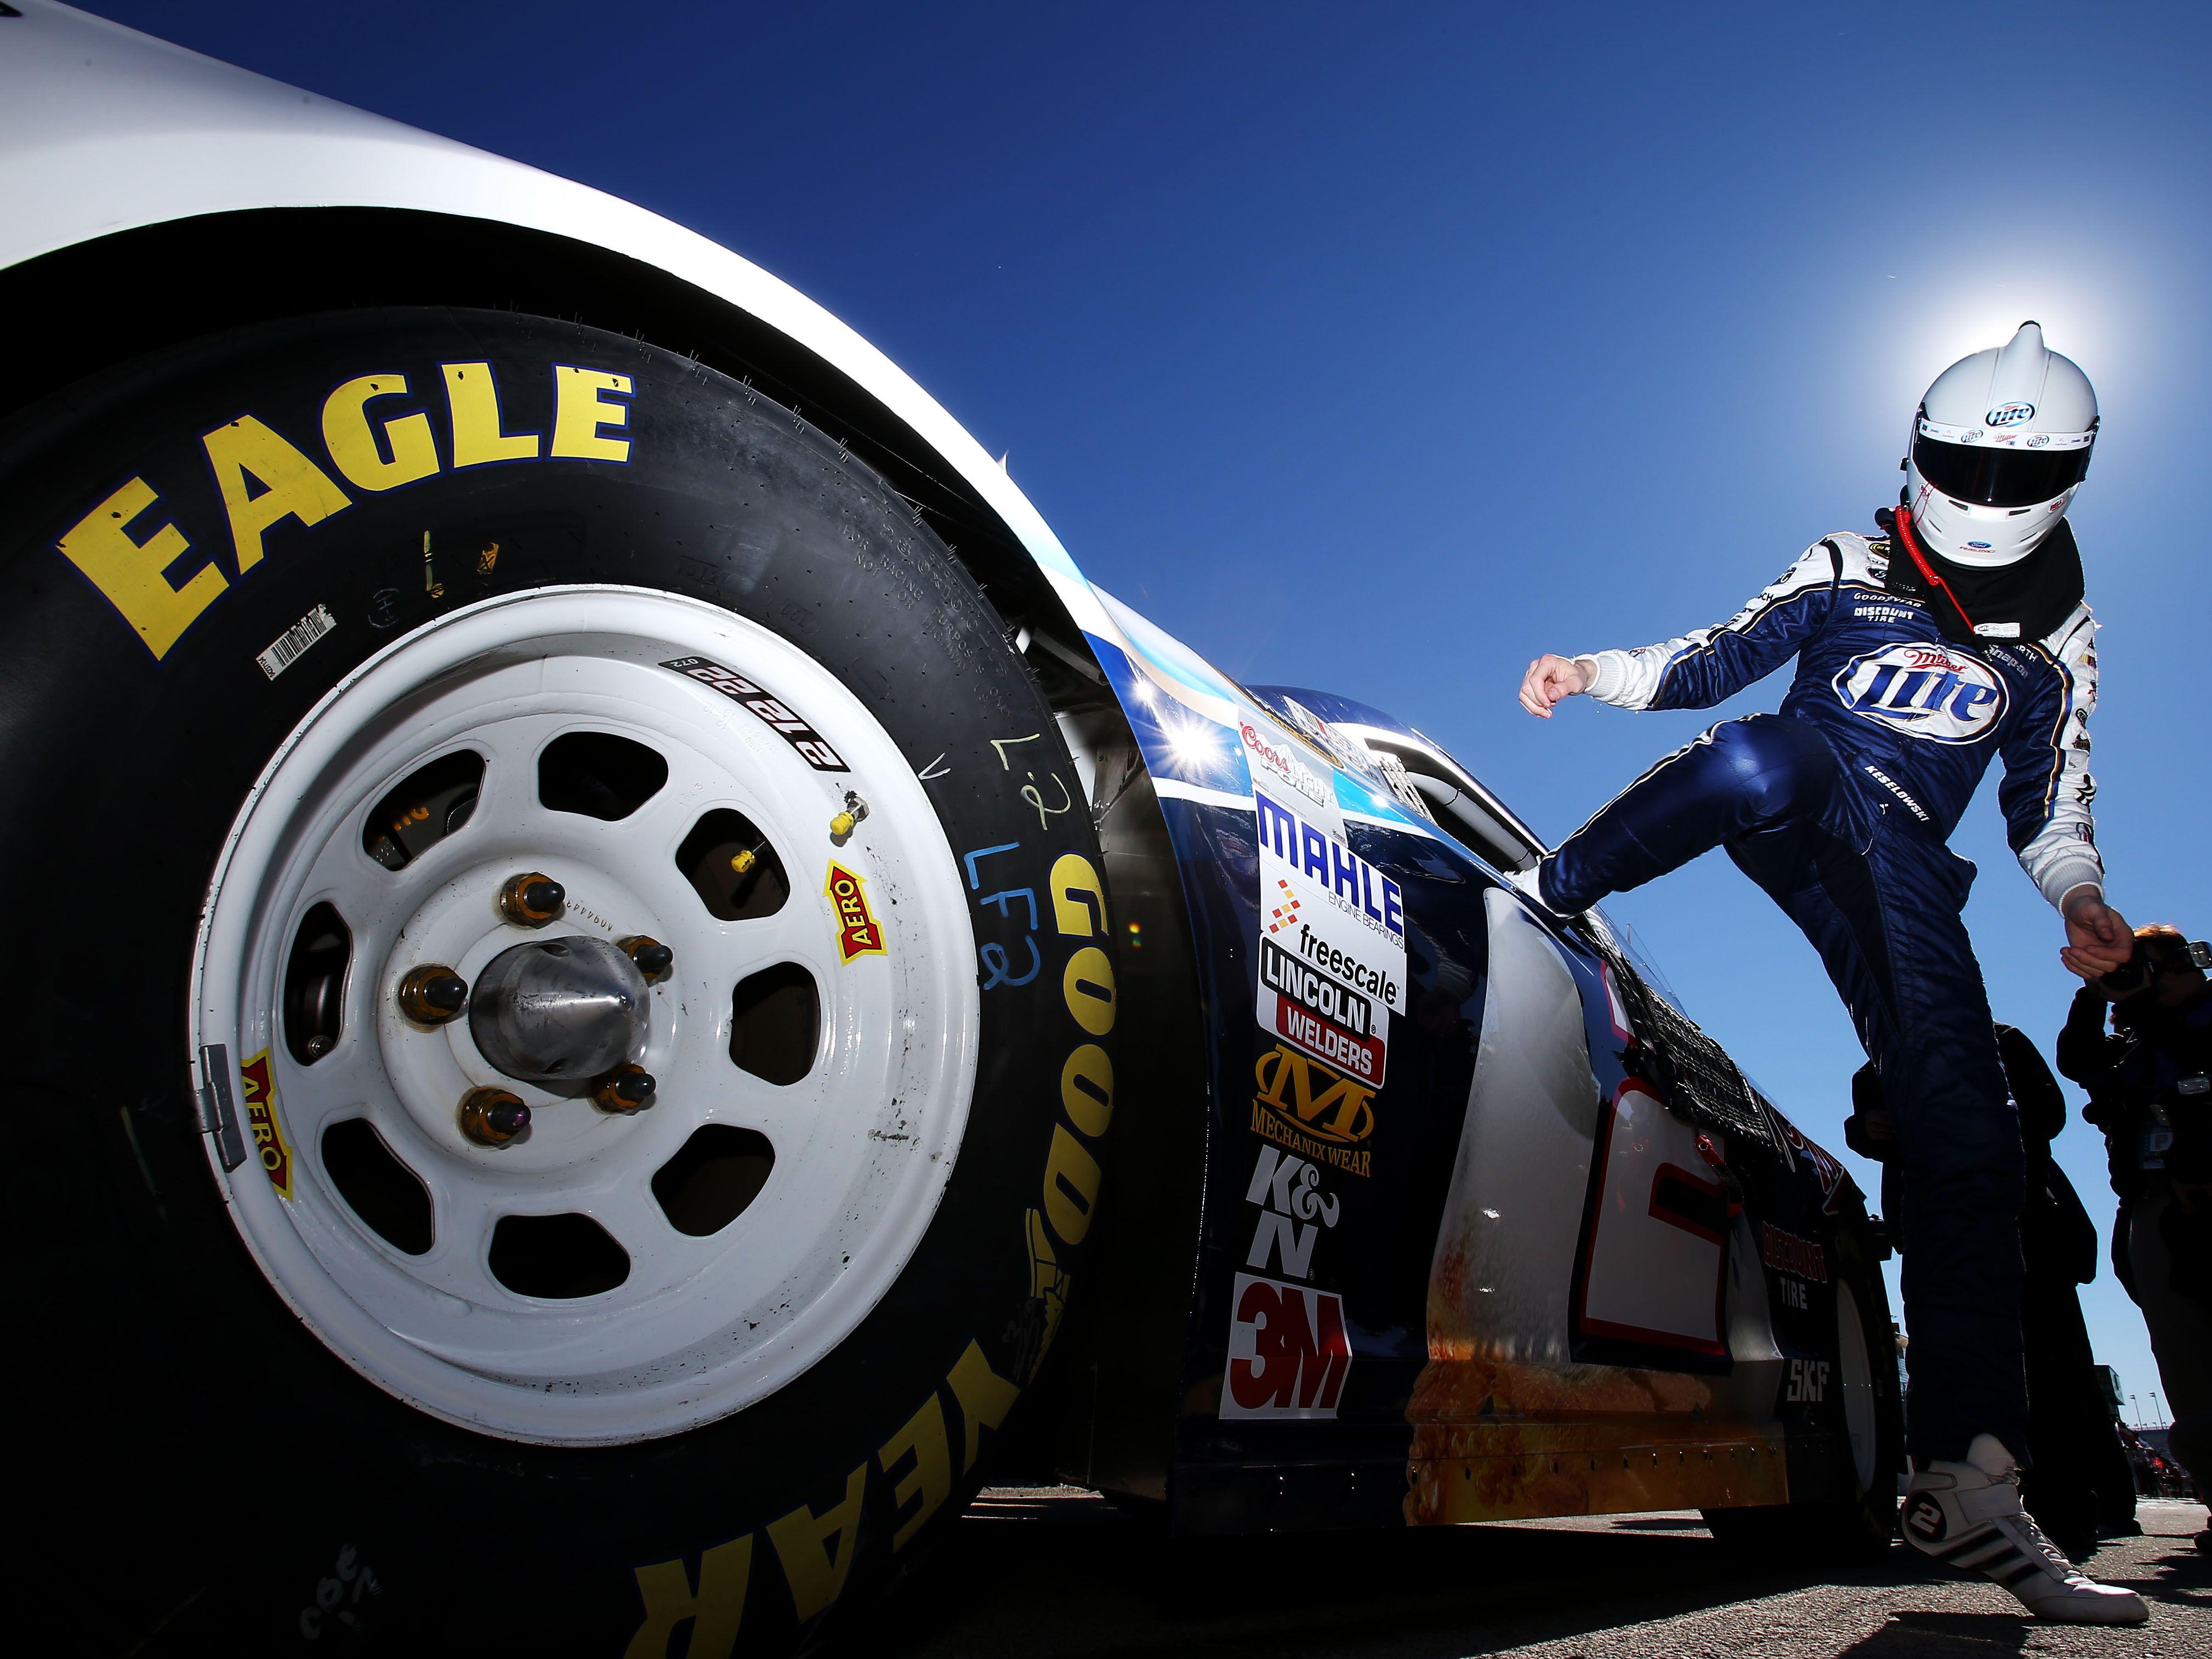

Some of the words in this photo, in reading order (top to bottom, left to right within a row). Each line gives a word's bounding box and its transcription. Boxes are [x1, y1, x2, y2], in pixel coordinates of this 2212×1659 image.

[1991, 408, 2030, 427] Lite
[55, 361, 633, 662] EAGLE
[1959, 546, 1997, 554] RACING
[1854, 606, 1914, 620] DISCOUNT
[1867, 616, 1895, 624] TIRE
[1850, 663, 1998, 723] Lite
[1239, 720, 1289, 771] Coors
[1289, 764, 1333, 803] LIGHT
[1260, 756, 1324, 808] POLE
[1864, 765, 1930, 822] KESELOWSKI
[1254, 789, 1403, 938] MAHLE
[832, 879, 873, 946] AERO
[1328, 890, 1361, 922] ENGINE
[1363, 914, 1404, 950] BEARINGS
[1265, 945, 1366, 1035] LINCOLN
[1300, 923, 1397, 1006] freescale
[1286, 1005, 1373, 1076] WELDERS
[242, 1075, 282, 1171] AERO
[1250, 1098, 1326, 1161] MECHANIX
[1327, 1146, 1371, 1178] WEAR
[1762, 1220, 1828, 1284] DISCOUNT
[1779, 1276, 1808, 1310] TIRE
[1229, 1281, 1346, 1410] 3M
[1787, 1358, 1830, 1402] SKF
[1909, 1502, 1941, 1534] 2
